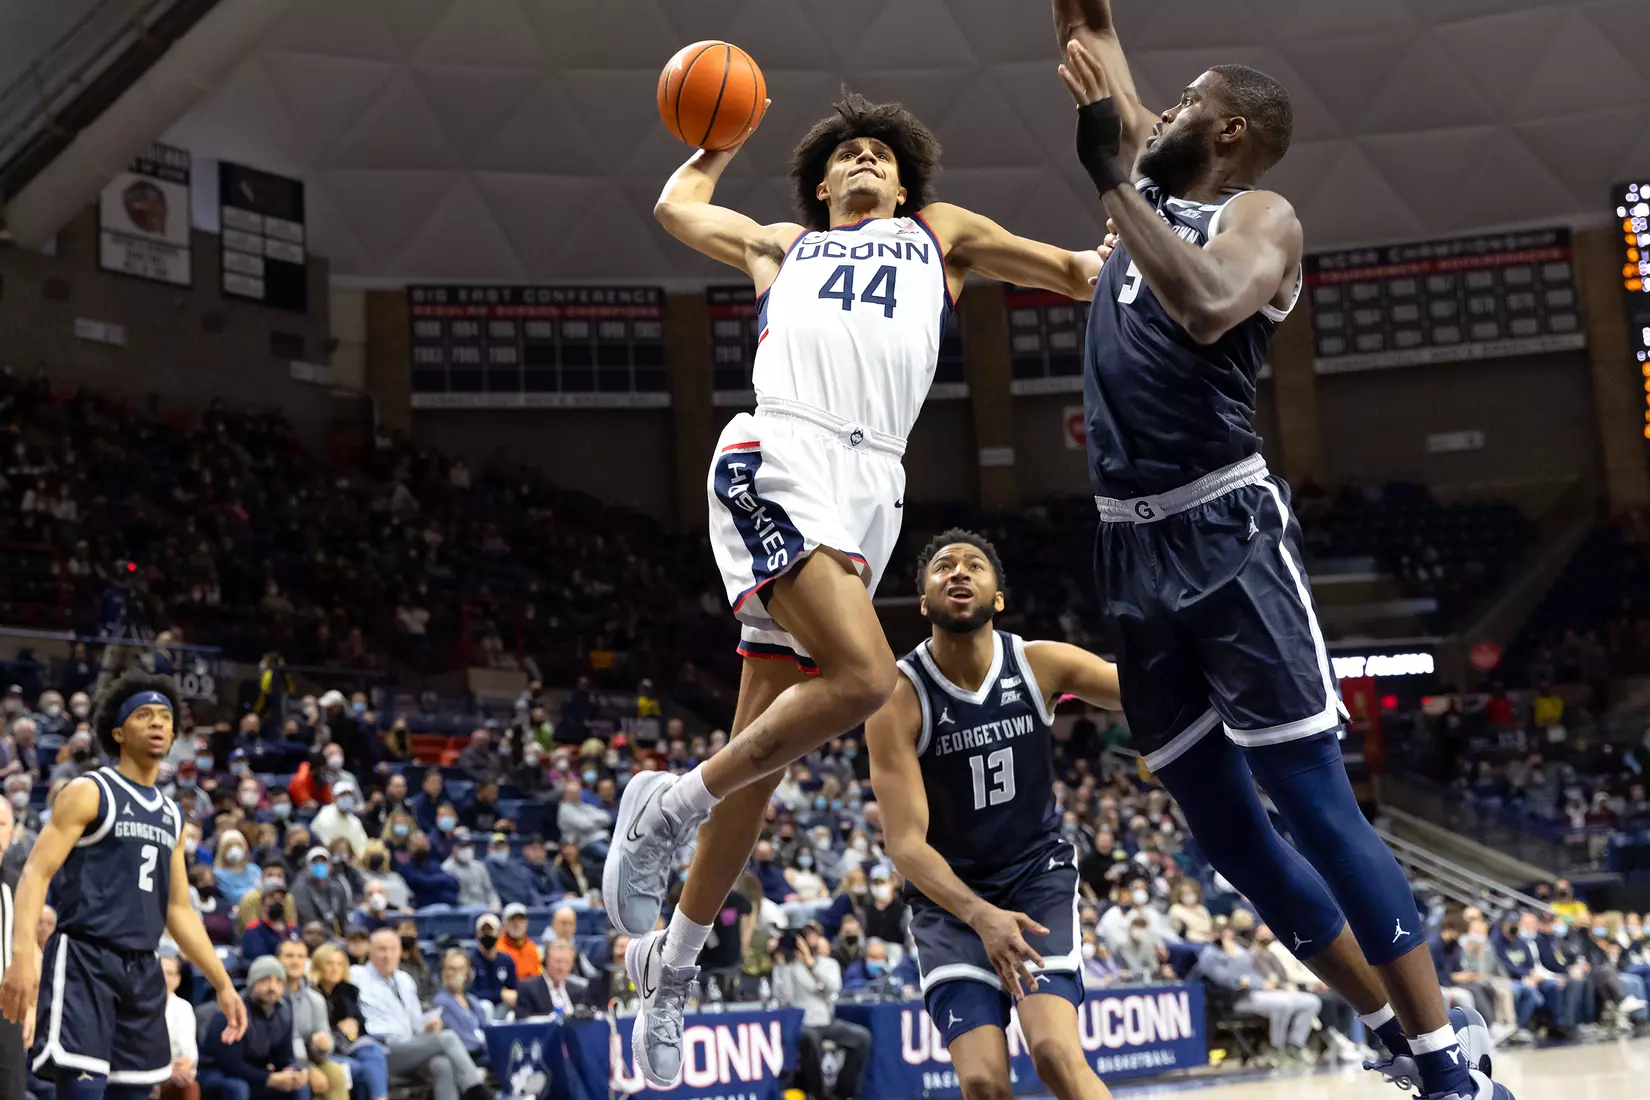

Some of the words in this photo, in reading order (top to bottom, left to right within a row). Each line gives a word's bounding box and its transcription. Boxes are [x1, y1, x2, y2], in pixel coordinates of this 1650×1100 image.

[796, 240, 929, 265] UCONN
[818, 264, 897, 319] 44
[727, 462, 788, 572] HUSKIES
[1134, 500, 1156, 520] G
[935, 714, 1034, 757] GEORGETOWN
[968, 746, 1016, 811] 13
[115, 820, 176, 852] GEORGETOW
[138, 844, 159, 892] 2
[1077, 990, 1193, 1052] UCONN
[609, 1020, 784, 1094] UONN
